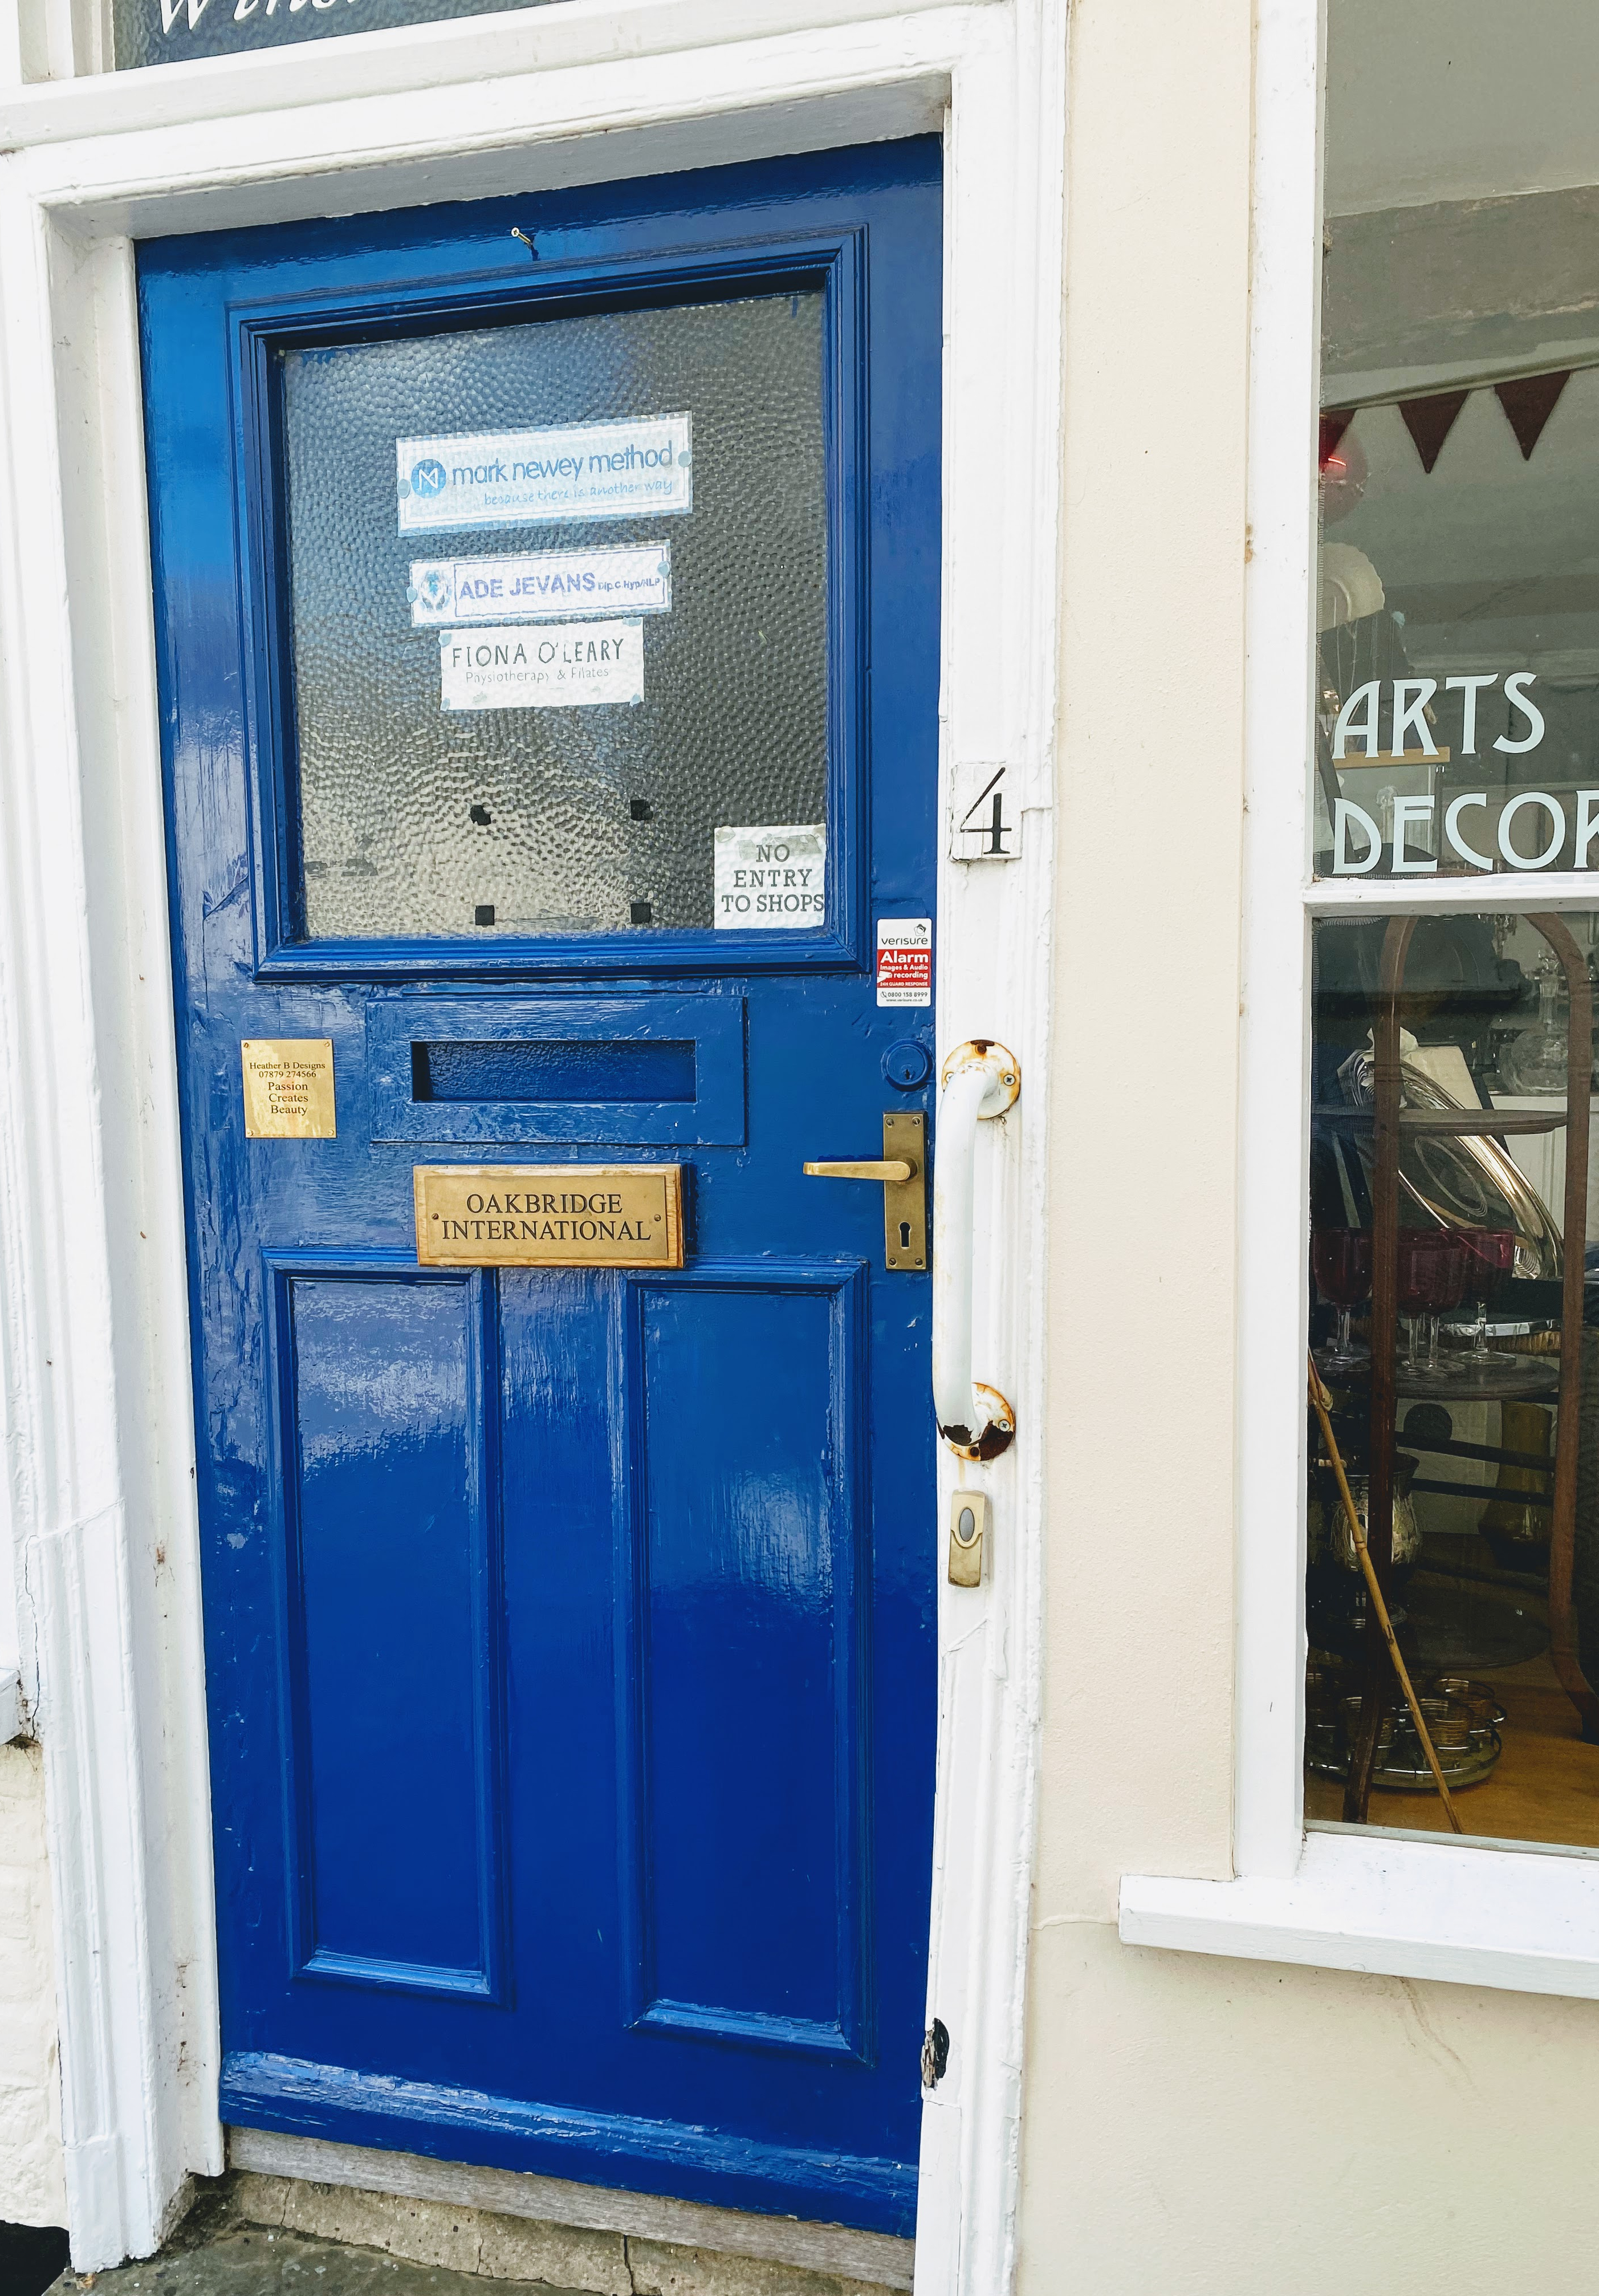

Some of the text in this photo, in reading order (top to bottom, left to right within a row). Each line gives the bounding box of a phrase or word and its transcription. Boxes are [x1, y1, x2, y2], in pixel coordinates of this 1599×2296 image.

[452, 458, 508, 485] mark
[513, 457, 584, 481] newey
[589, 440, 672, 473] method
[485, 479, 673, 505] because there is another way
[459, 578, 503, 600] ADE
[510, 572, 595, 597] JEVANS
[453, 638, 624, 667] FIONA O'LEARY
[466, 667, 609, 685] Physiotherapy & Pilates
[1331, 671, 1545, 759] ARTS
[960, 766, 1012, 854] 4
[756, 844, 791, 862] NO
[733, 869, 812, 887] ENTRY
[721, 894, 824, 912] TO SHOPS
[880, 950, 929, 963] Alarm
[893, 971, 929, 980] recording
[292, 1062, 326, 1070] Designs
[268, 1082, 308, 1091] Passion
[269, 1094, 308, 1102] Creates
[271, 1105, 308, 1116] Beauty
[466, 1193, 623, 1214] OAKBRIDGE
[442, 1220, 652, 1241] INTERNATIONAL
